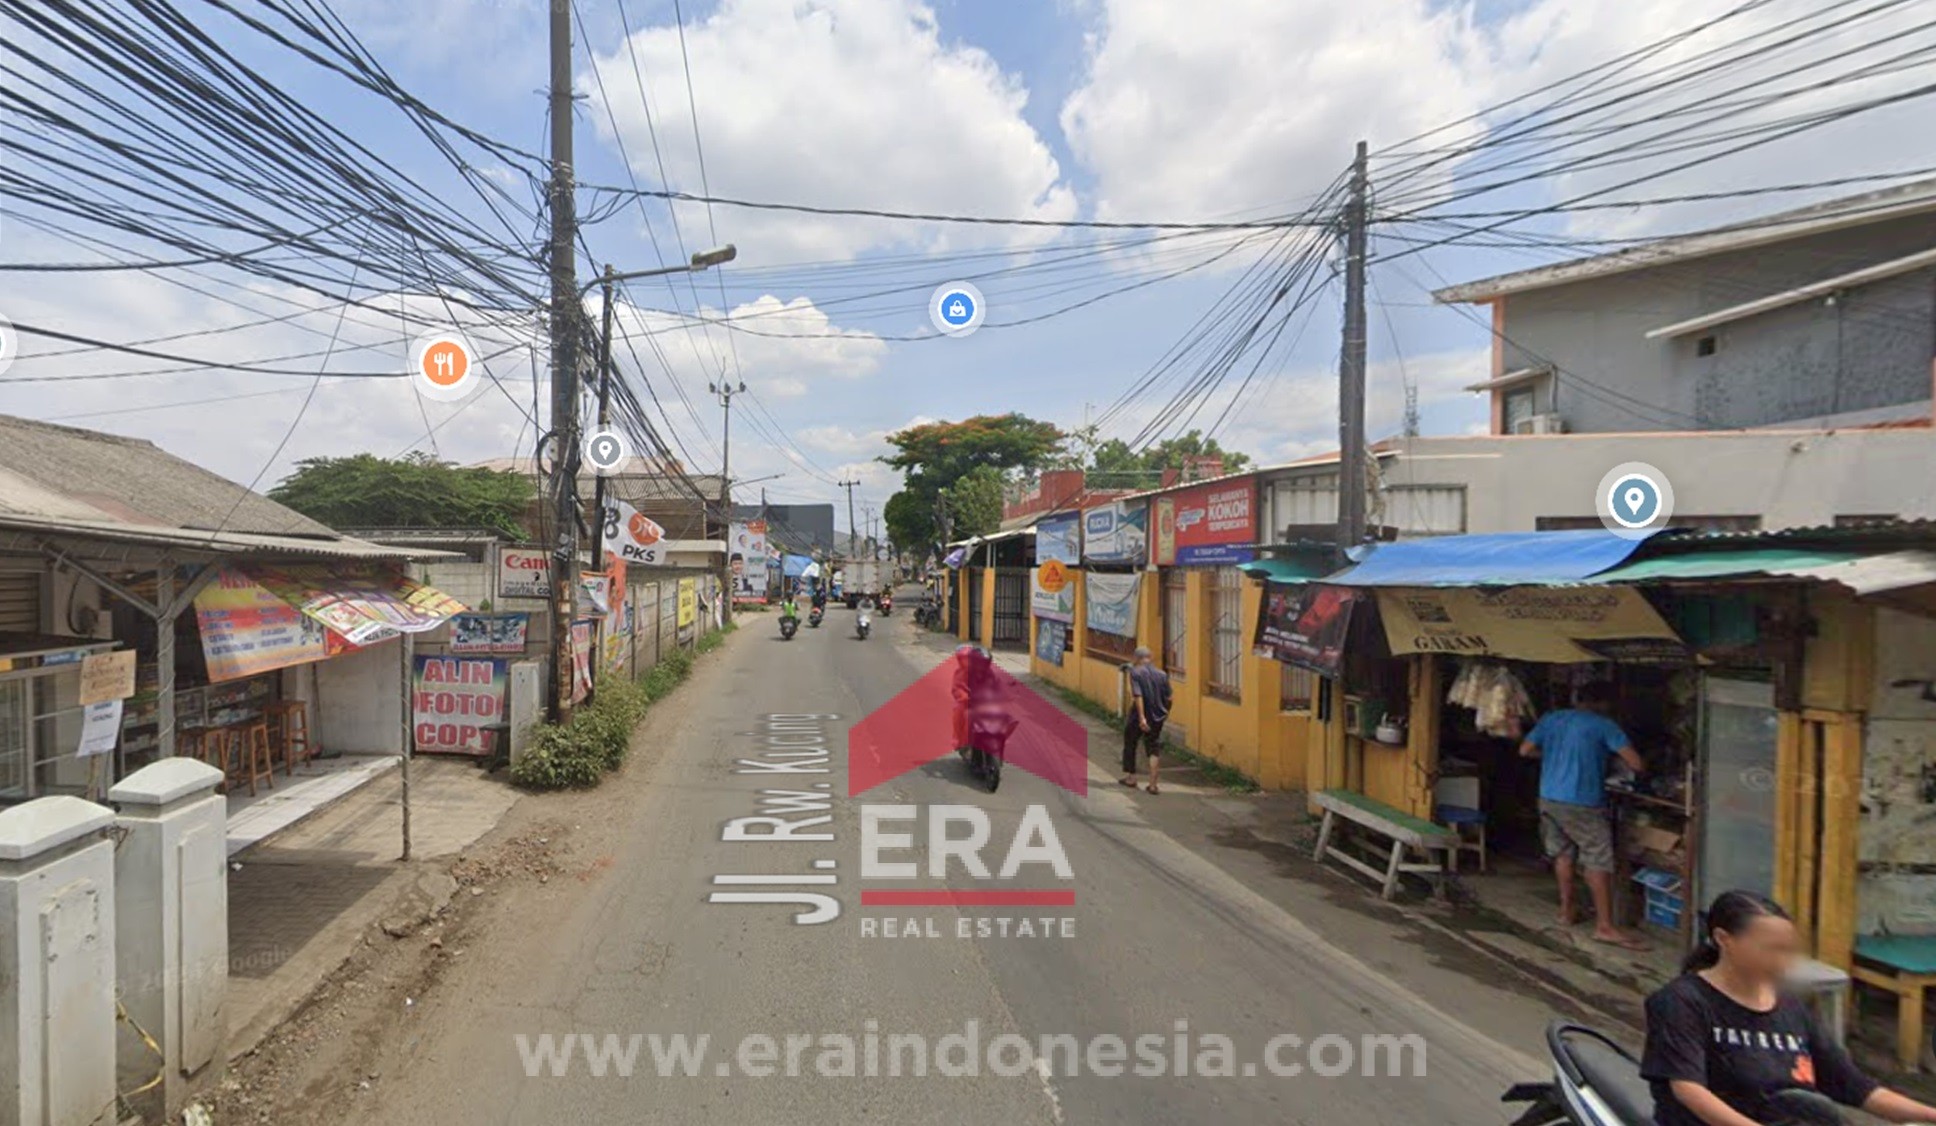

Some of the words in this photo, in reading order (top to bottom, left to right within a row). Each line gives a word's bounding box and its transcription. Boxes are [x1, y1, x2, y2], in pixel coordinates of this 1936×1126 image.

[1208, 499, 1249, 521] KOKOH
[505, 554, 550, 570] Can
[622, 544, 656, 562] PKS
[1413, 634, 1488, 652] GARAM
[422, 659, 493, 685] ALIN
[419, 691, 493, 717] FOTO
[416, 722, 494, 749] COPY
